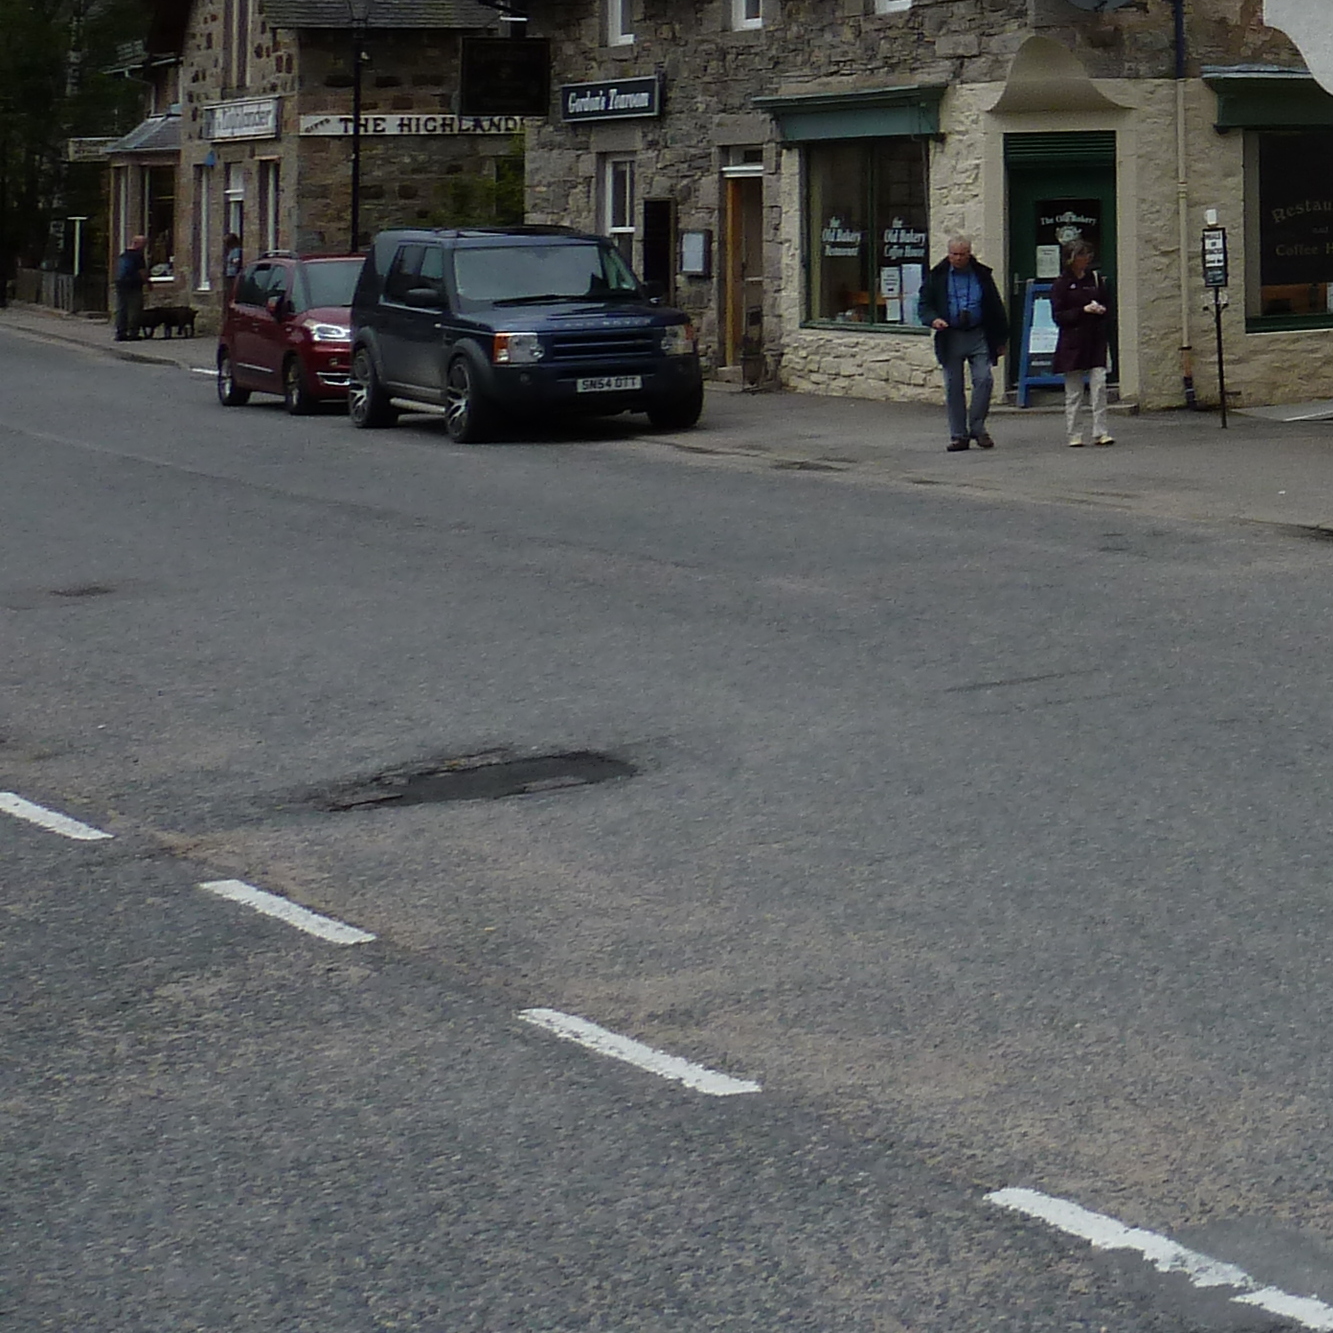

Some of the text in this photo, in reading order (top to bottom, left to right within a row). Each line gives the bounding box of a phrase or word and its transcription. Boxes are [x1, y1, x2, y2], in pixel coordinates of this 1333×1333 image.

[339, 117, 387, 134] THE
[1041, 217, 1055, 226] The
[822, 228, 861, 246] Old Bakery
[884, 229, 926, 247] Old Bakery
[1275, 243, 1319, 257] Coffee
[582, 379, 611, 390] SN54
